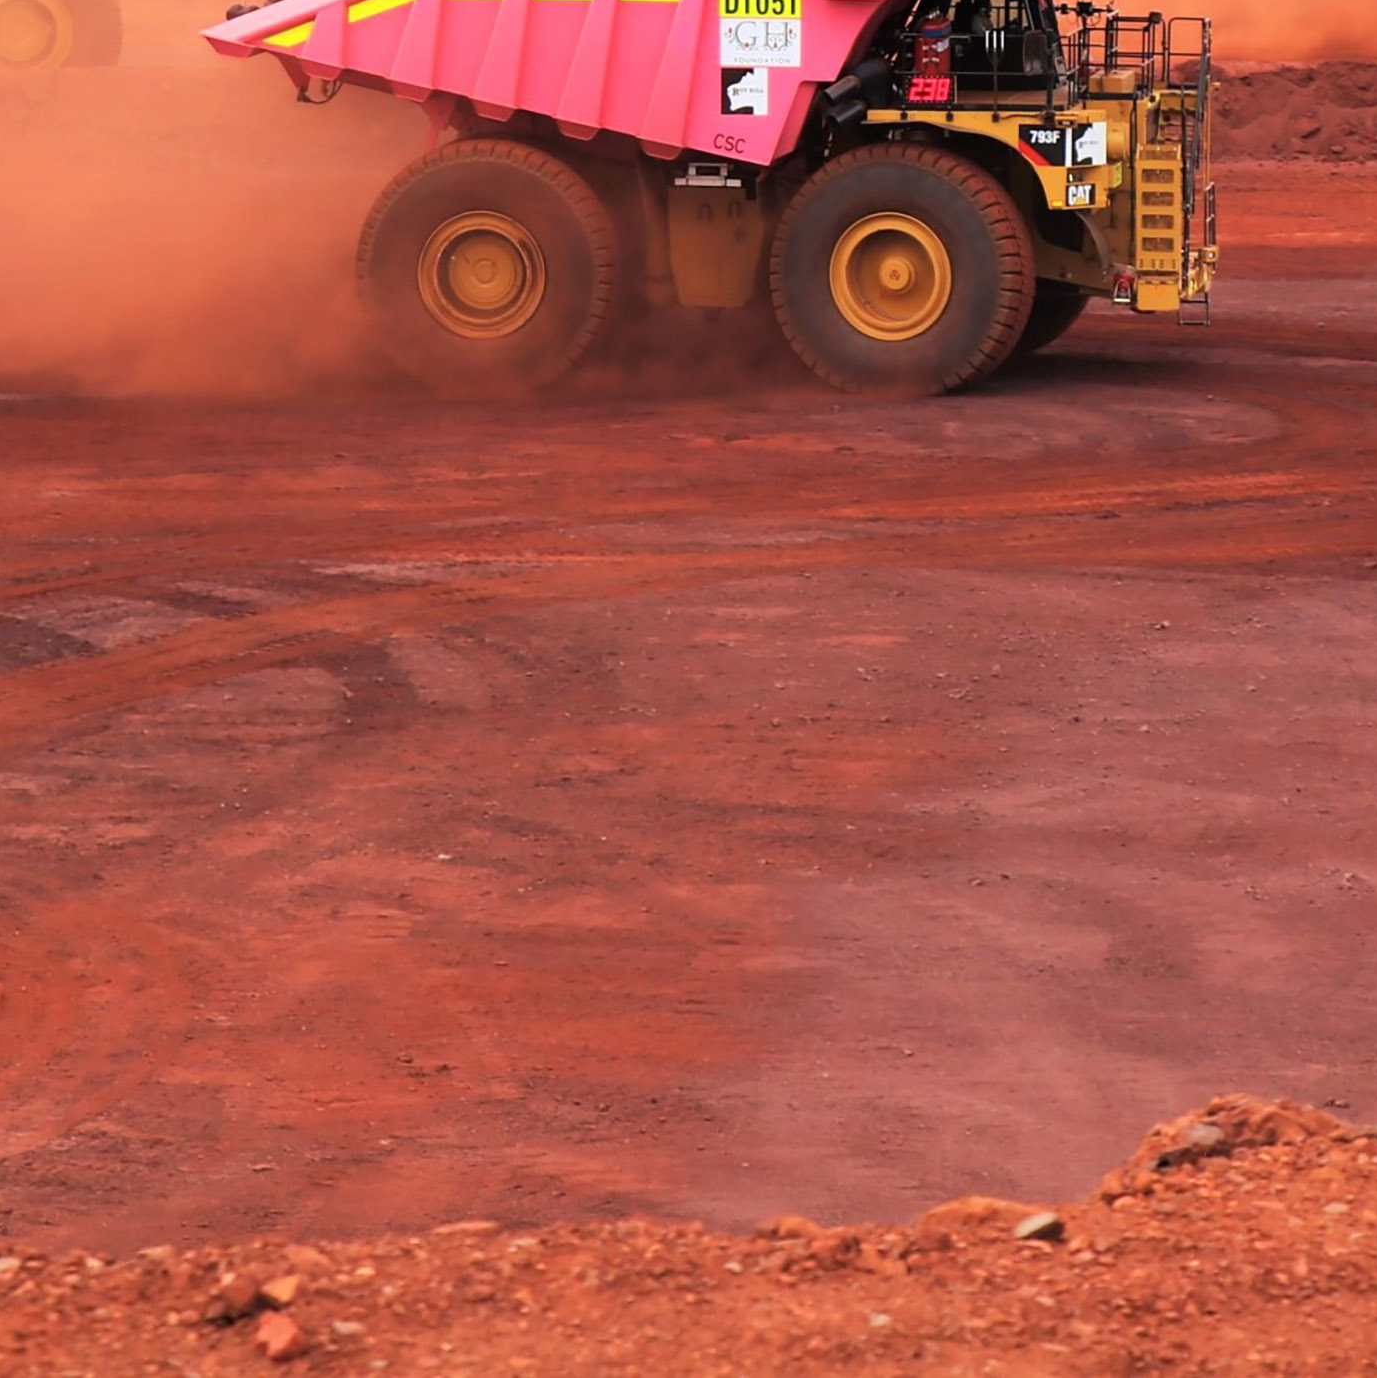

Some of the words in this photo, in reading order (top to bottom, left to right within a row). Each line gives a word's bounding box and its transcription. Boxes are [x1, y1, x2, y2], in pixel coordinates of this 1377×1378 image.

[908, 77, 951, 101] 238
[713, 133, 746, 154] CSC
[1029, 130, 1061, 144] 793F
[1068, 184, 1092, 206] CAT
